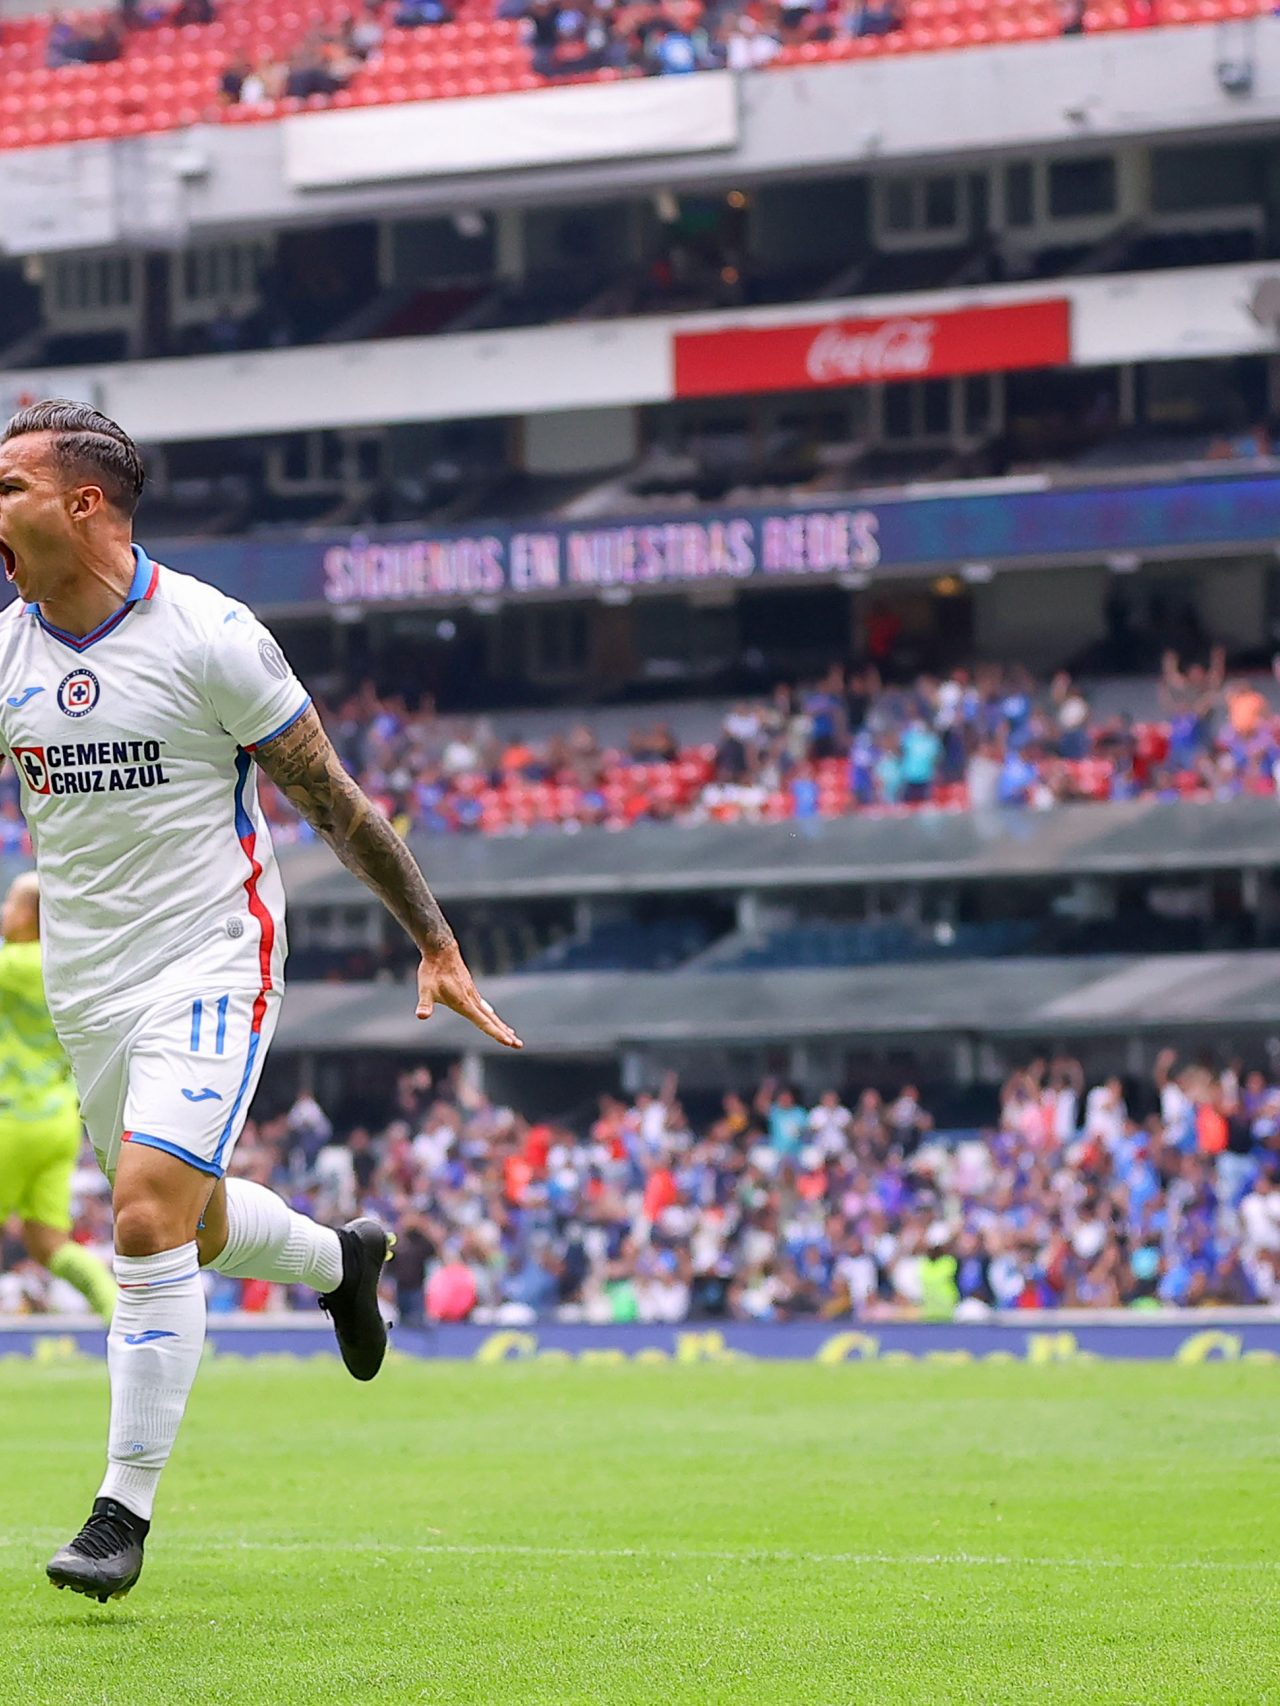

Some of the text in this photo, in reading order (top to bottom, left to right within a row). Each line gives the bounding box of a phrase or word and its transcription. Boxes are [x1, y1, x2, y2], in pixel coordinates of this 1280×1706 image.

[806, 317, 937, 383] Coca-Cola
[323, 510, 881, 604] SÍGUENOS EN NUESTRAS REDES
[46, 740, 161, 768] CEMENTO
[50, 764, 170, 795] CRUZ AZUL
[190, 992, 229, 1055] 11
